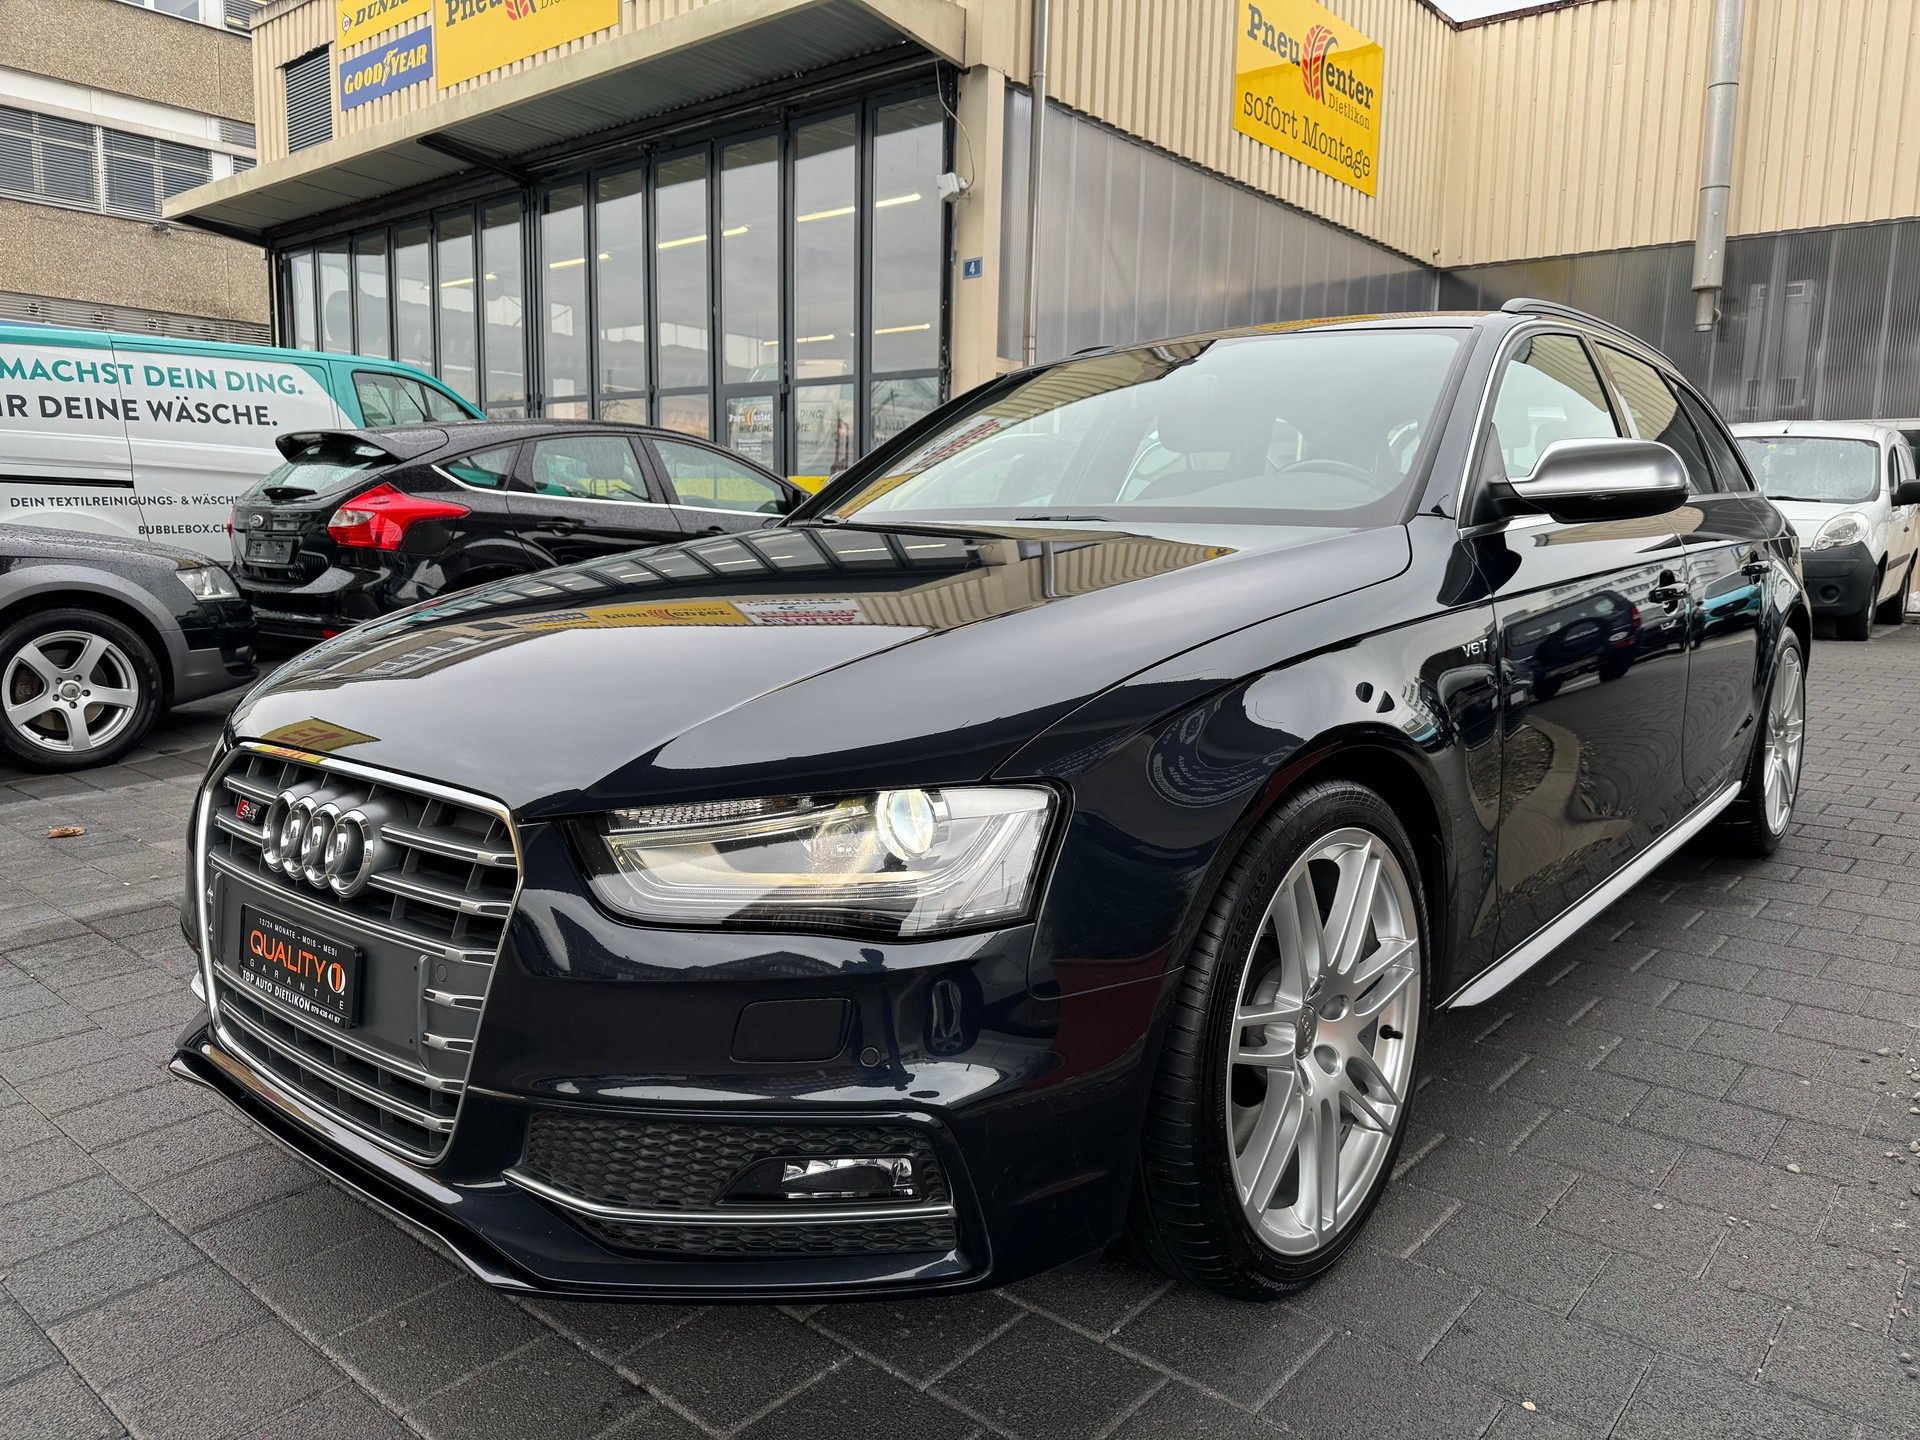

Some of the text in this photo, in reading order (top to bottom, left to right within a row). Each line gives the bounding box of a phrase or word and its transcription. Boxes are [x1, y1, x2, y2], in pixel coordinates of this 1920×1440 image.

[354, 0, 409, 27] DUNL
[1247, 3, 1301, 67] Pneu
[1328, 92, 1371, 130] Dietlikon
[1302, 115, 1371, 179] Montage
[969, 261, 976, 275] 4
[0, 357, 304, 395] MACHST DEIN DING.
[0, 394, 279, 427] R DEINE WÄSCHE.
[10, 497, 45, 508] DEIN
[48, 496, 178, 507] TEXTILREINIGUNGS-
[182, 496, 189, 505] &
[259, 917, 273, 929] 12/24
[274, 924, 296, 939] MONATE
[302, 935, 317, 948] MOIS
[323, 944, 338, 957] MESI
[250, 930, 327, 983] QUALITY
[242, 969, 255, 983] TOP
[255, 976, 272, 993] AUTO
[274, 985, 311, 1012] DIETLIKON
